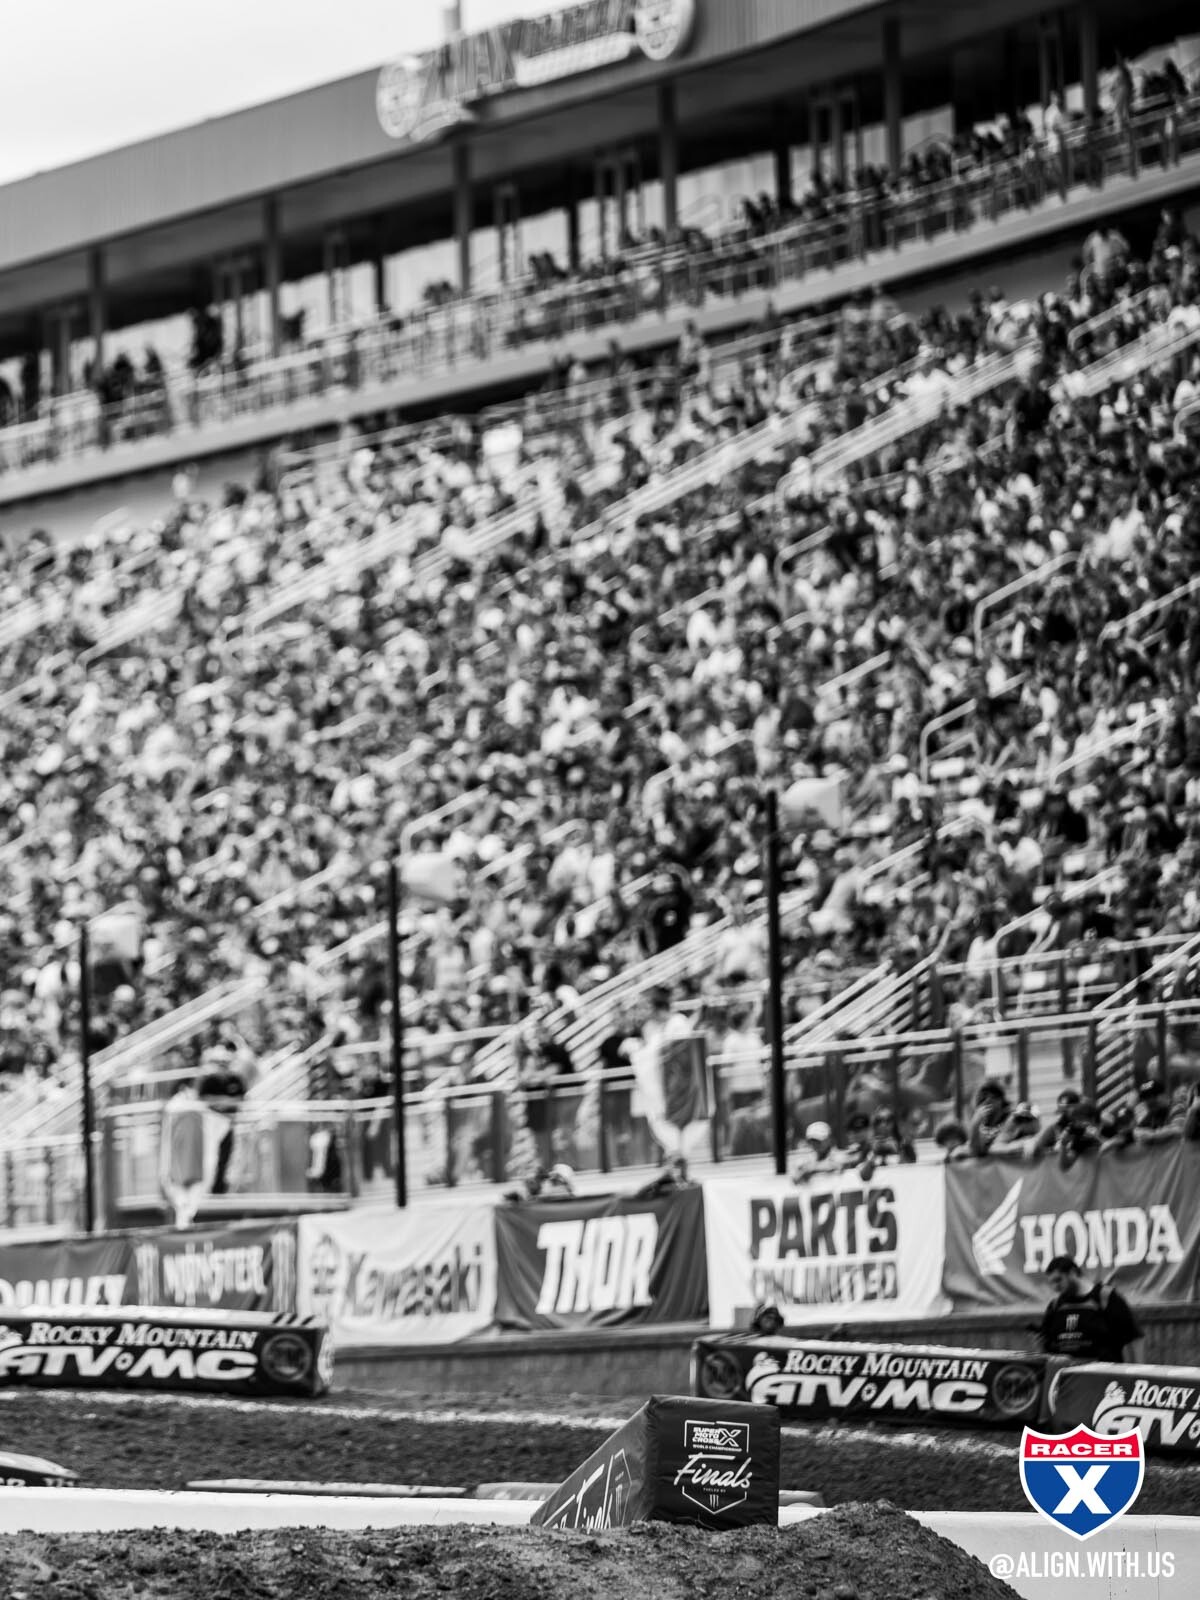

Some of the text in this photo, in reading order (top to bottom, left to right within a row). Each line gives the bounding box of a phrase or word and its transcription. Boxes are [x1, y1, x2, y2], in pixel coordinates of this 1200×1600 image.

[751, 1188, 898, 1260] PARTS
[1020, 1204, 1184, 1273] HONDA
[347, 1244, 483, 1319] Kawasaki
[535, 1212, 659, 1315] THOR
[751, 1262, 898, 1304] UNLIMITED
[28, 1322, 258, 1350] ROCKY MOUNTAIN
[784, 1350, 990, 1380] ROCKY MOUNTAIN
[1128, 1380, 1195, 1409] ROCKY
[674, 1452, 753, 1489] Finals
